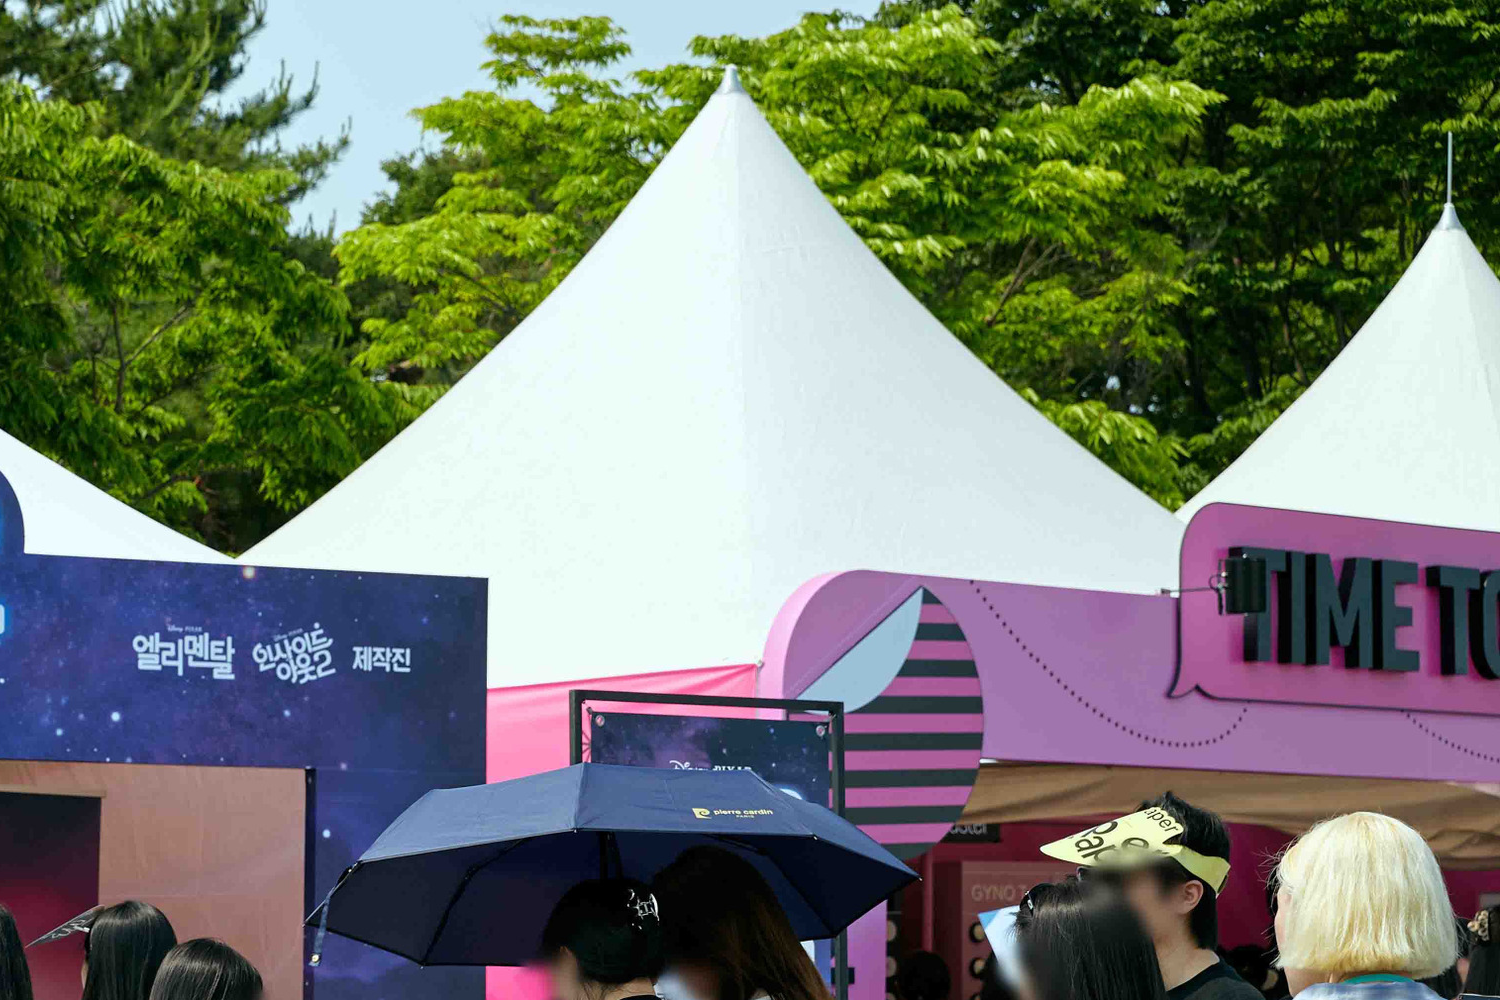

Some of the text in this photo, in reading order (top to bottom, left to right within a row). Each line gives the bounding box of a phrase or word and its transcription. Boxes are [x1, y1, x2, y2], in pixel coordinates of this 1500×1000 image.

[1228, 546, 1420, 673] TIME
[132, 632, 236, 681] 엘리멘탈
[252, 627, 334, 672] 인사이드
[352, 646, 412, 673] 제작진
